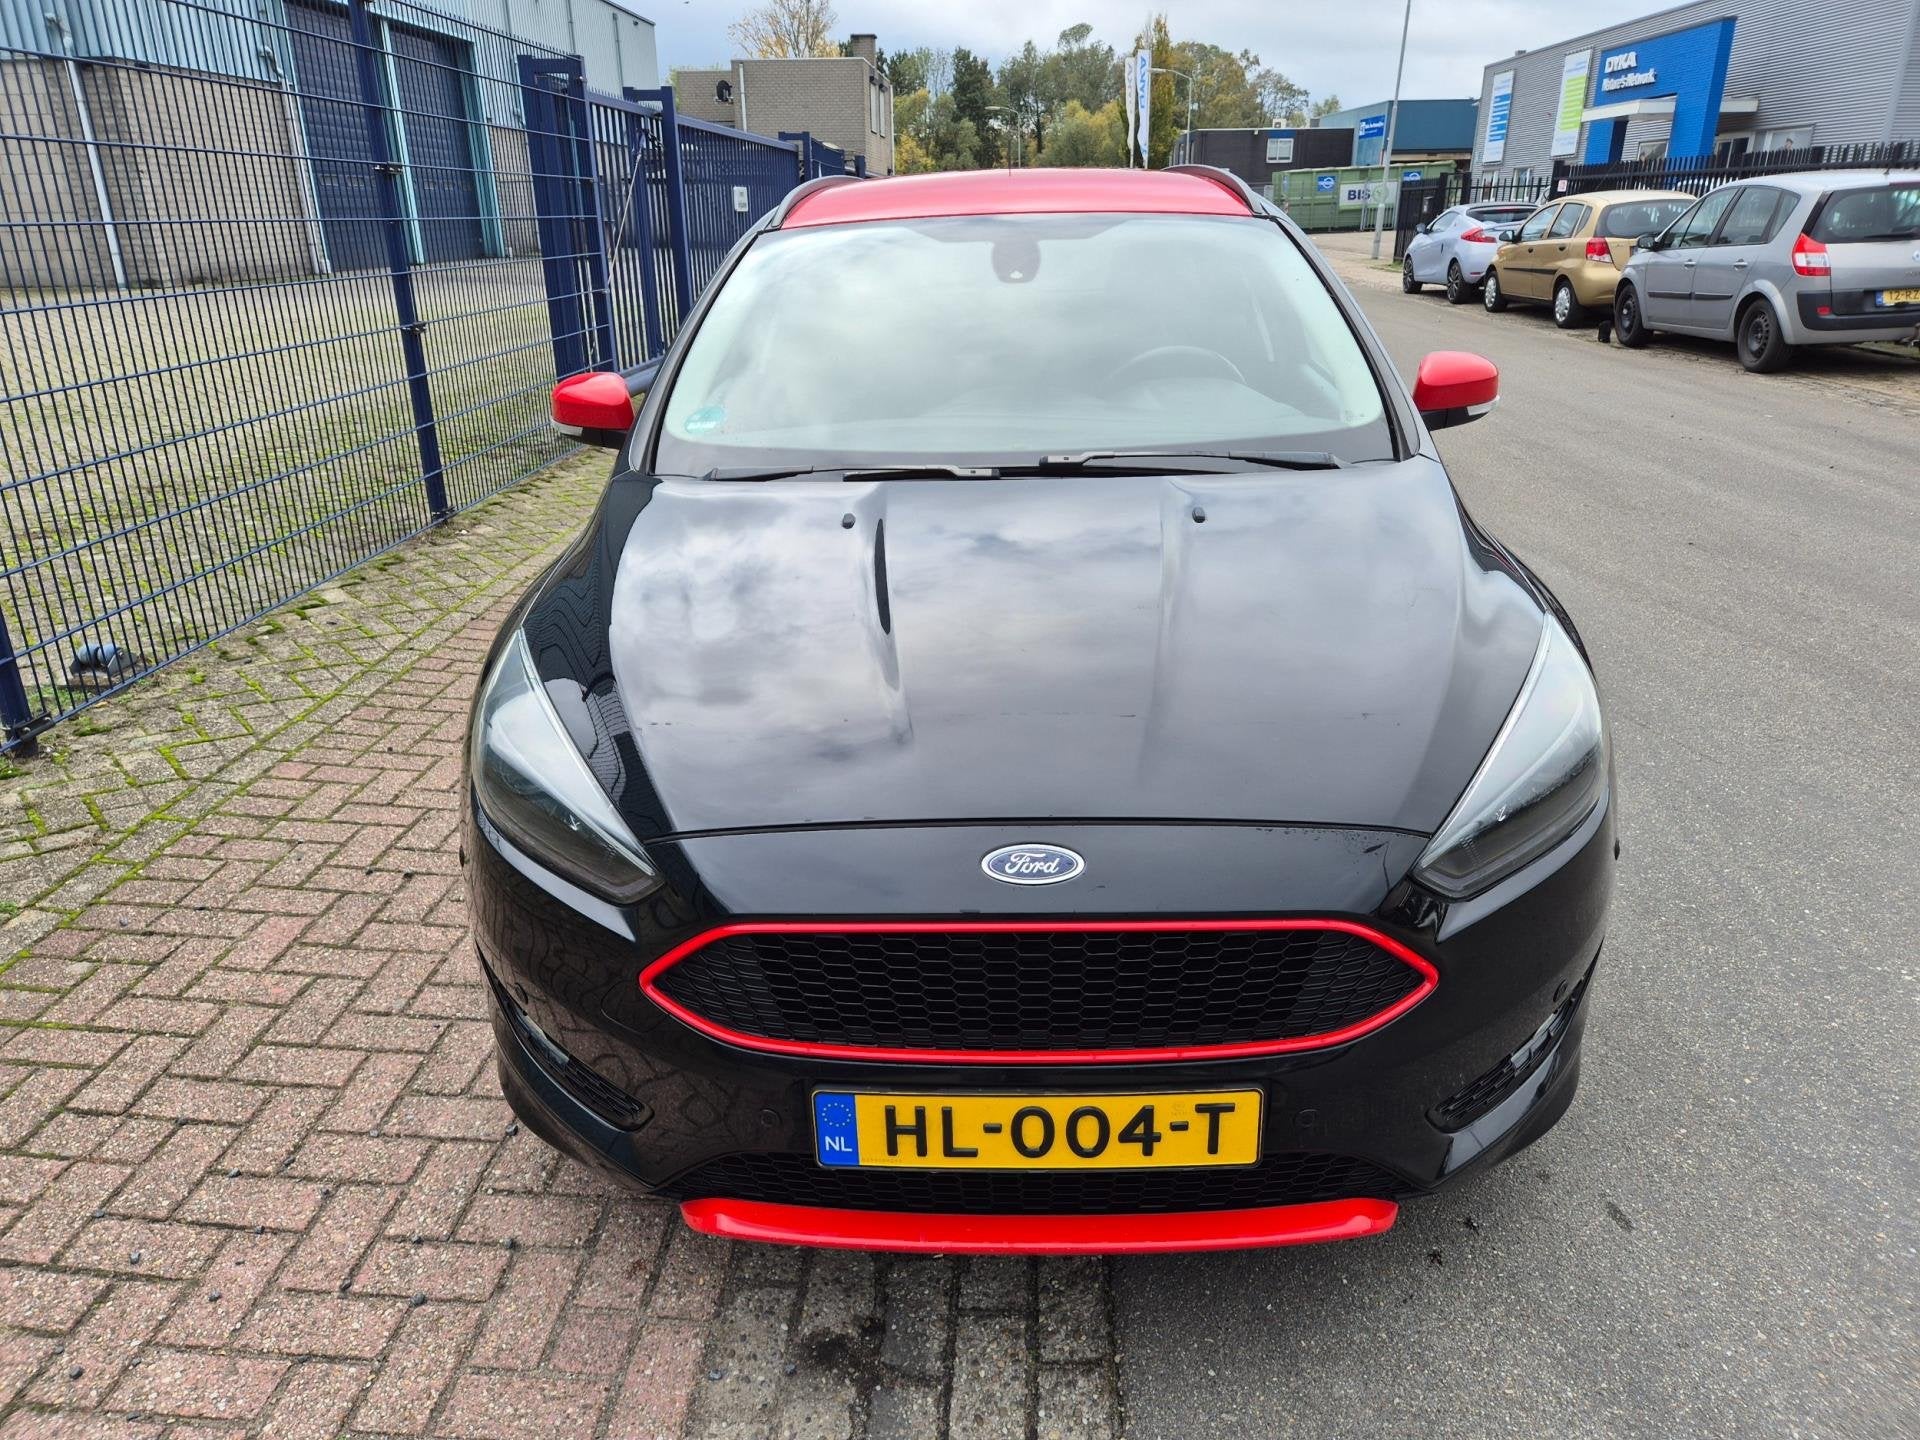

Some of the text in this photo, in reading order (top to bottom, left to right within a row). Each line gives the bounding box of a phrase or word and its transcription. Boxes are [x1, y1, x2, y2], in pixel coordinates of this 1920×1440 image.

[1604, 52, 1637, 73] DYKA
[1005, 852, 1060, 873] Ford
[885, 1103, 1235, 1158] HL-004-T
[825, 1136, 852, 1151] NL
